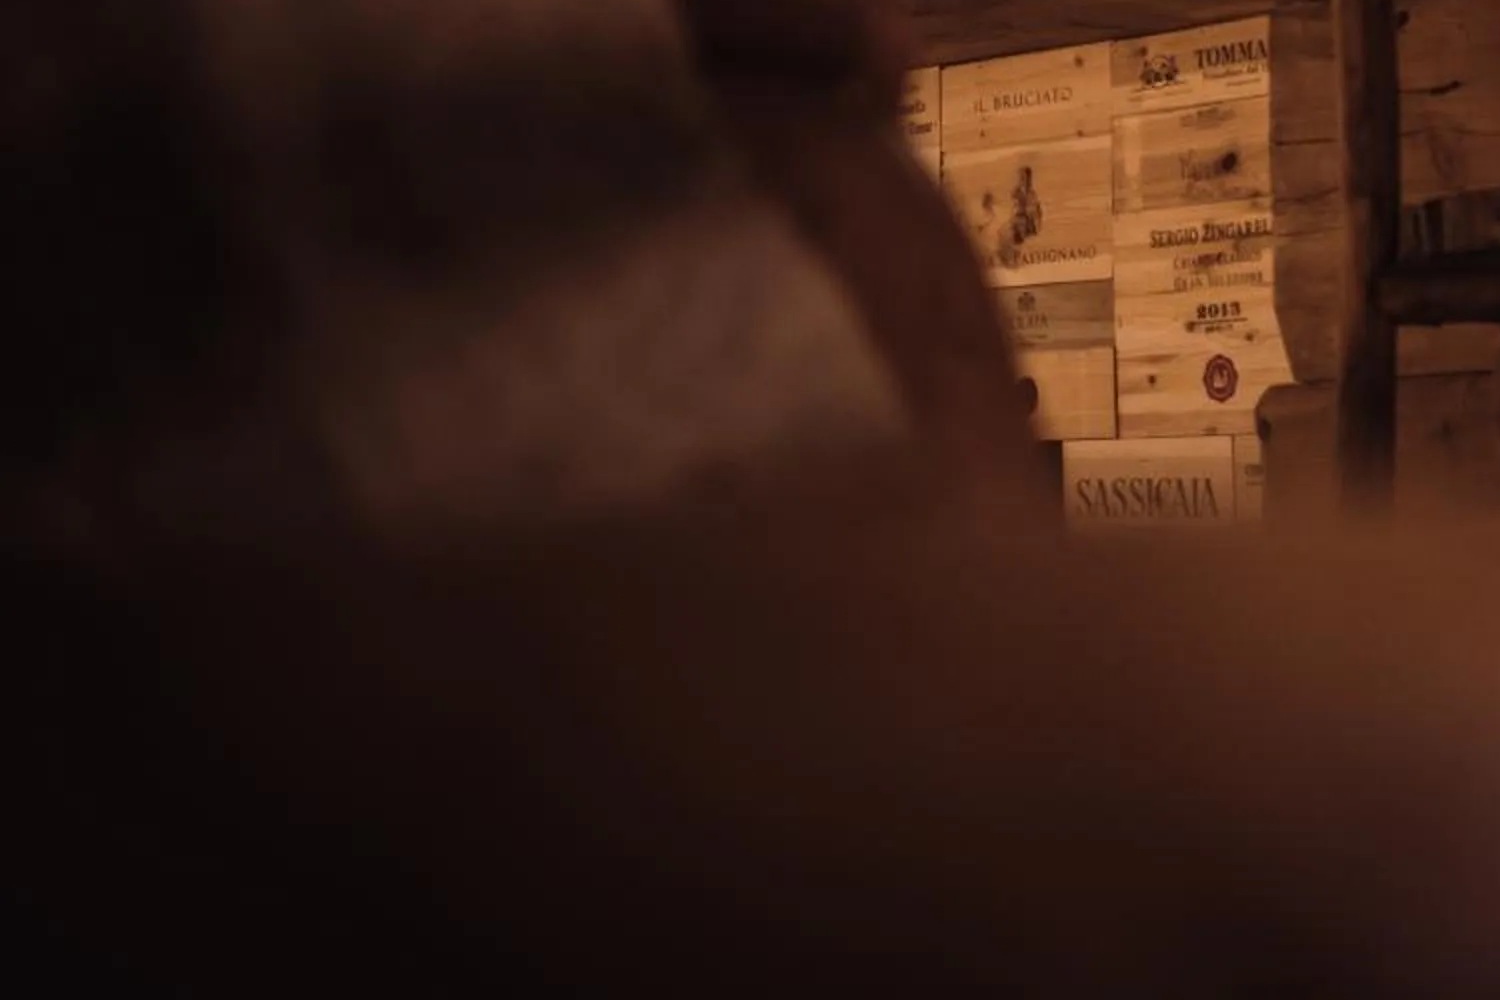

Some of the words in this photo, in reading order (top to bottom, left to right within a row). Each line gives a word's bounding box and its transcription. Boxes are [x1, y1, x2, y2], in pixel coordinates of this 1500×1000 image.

[1194, 39, 1268, 69] TOMMA
[993, 87, 1073, 112] BRUCIATO
[1150, 227, 1199, 248] SERGIO
[1196, 302, 1241, 319] 2013
[1077, 476, 1219, 518] SASSICAIA
